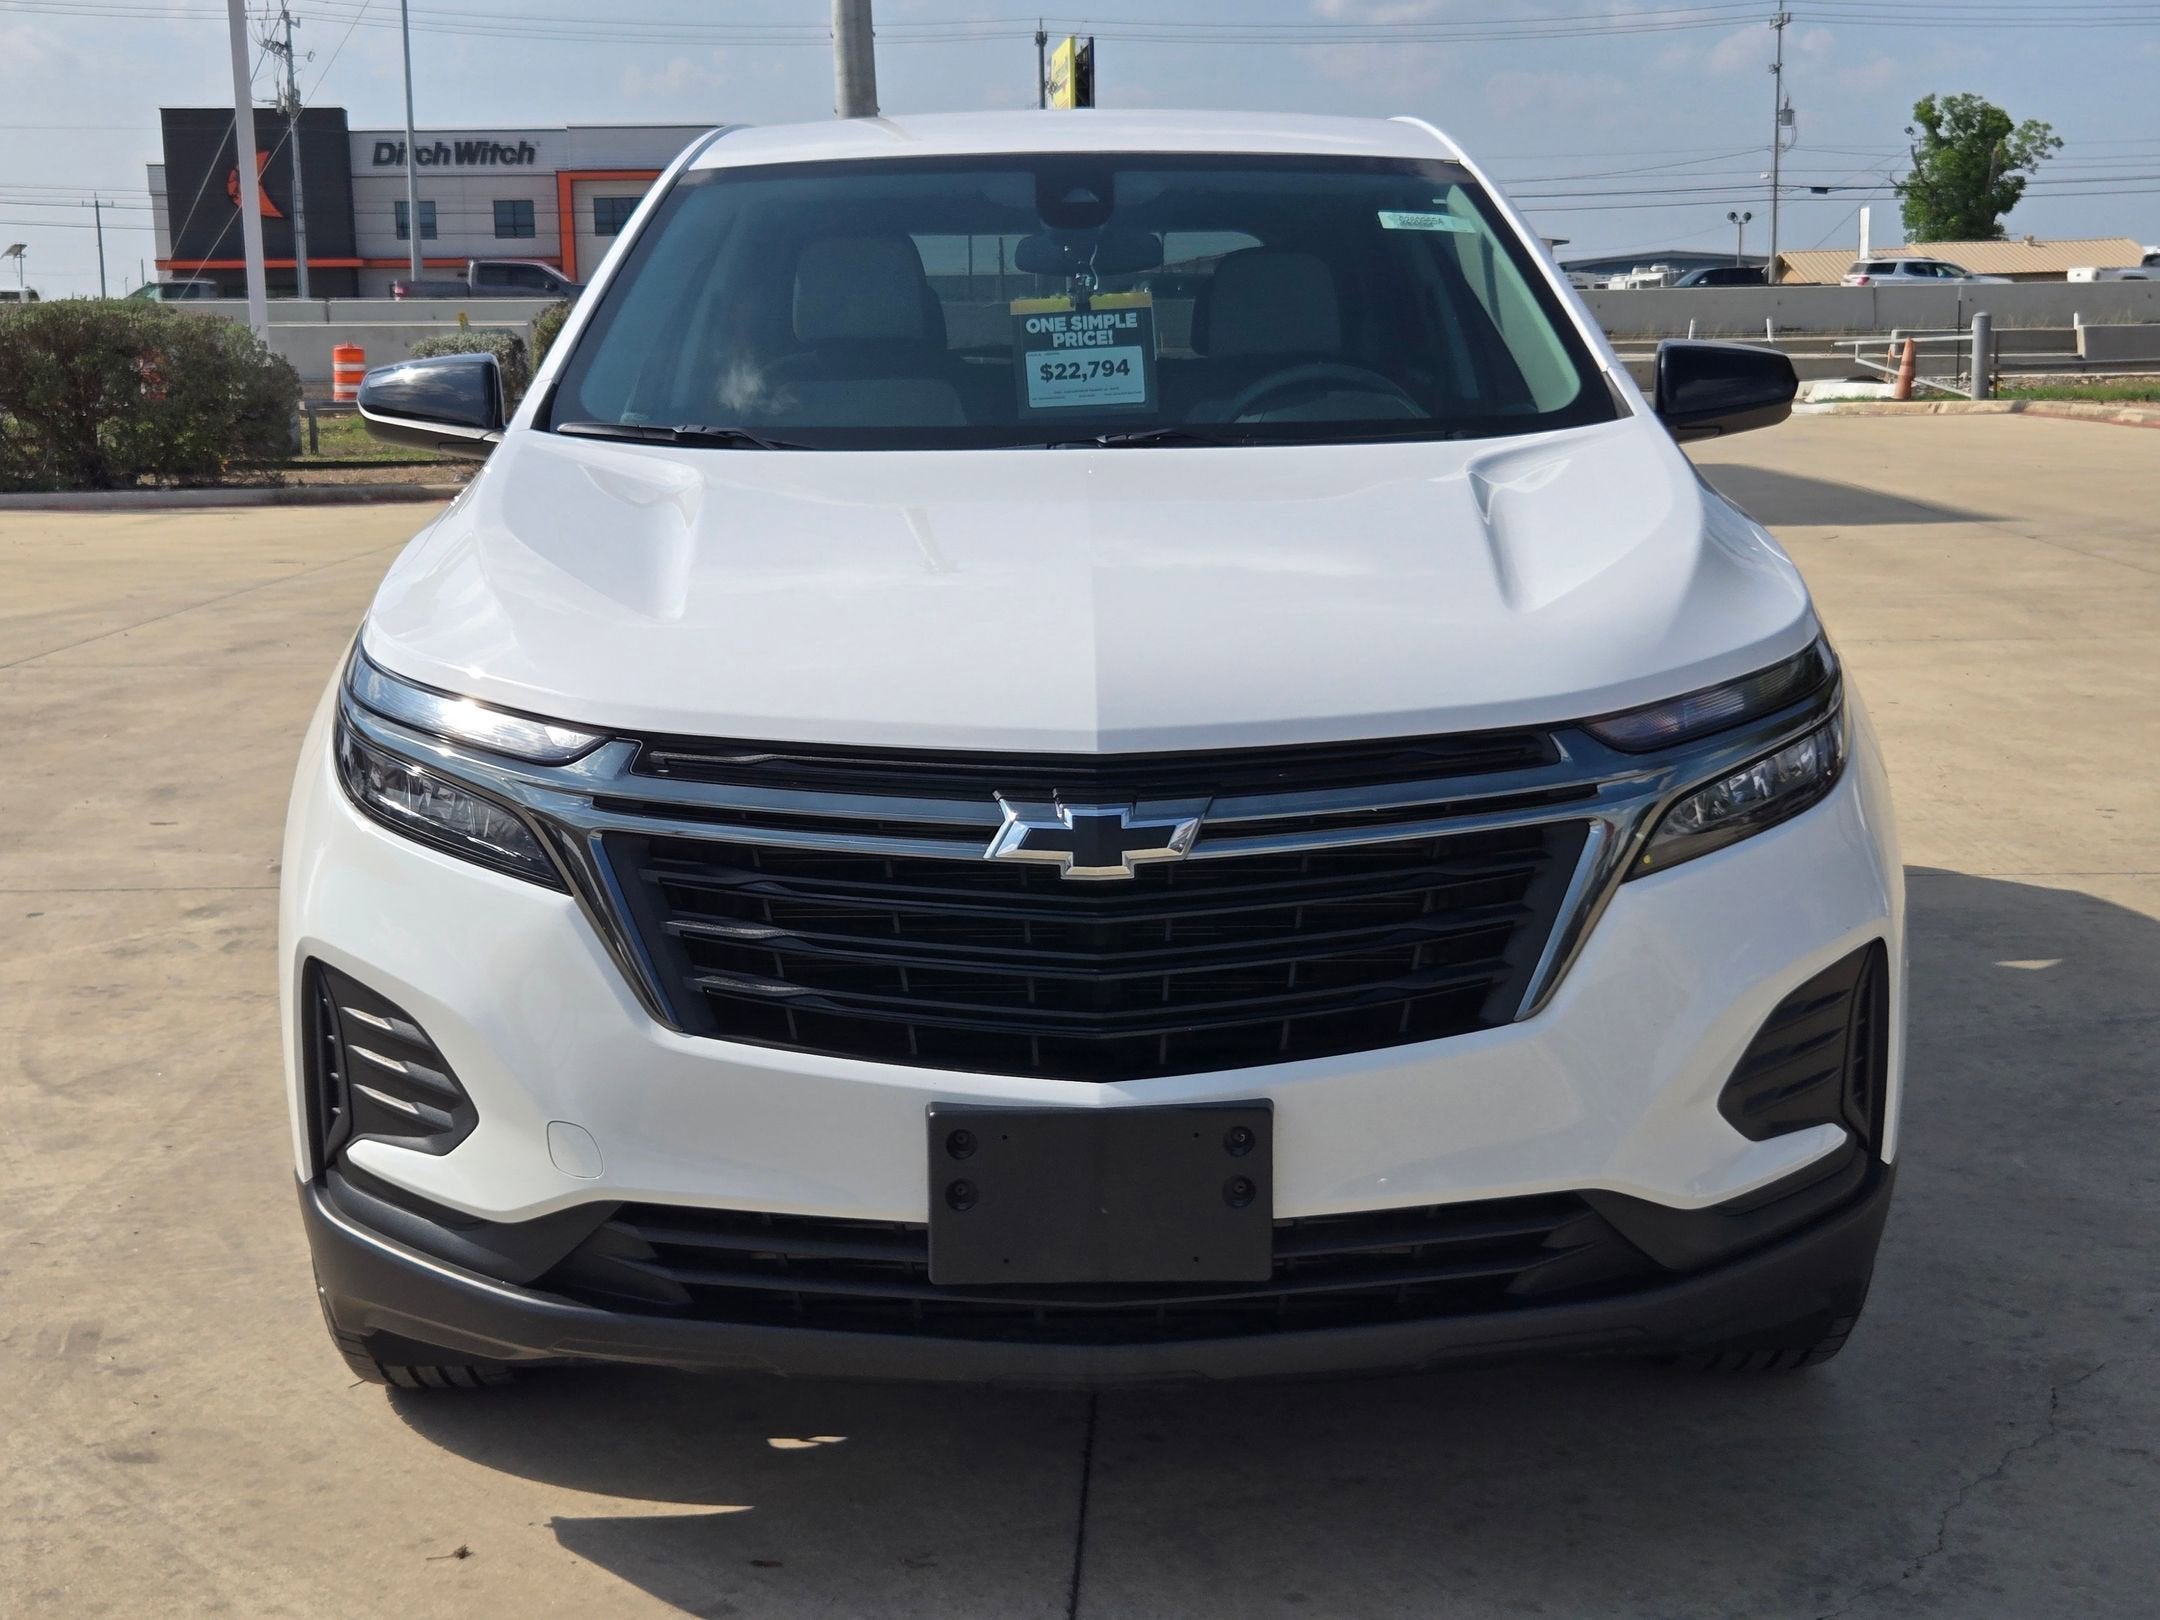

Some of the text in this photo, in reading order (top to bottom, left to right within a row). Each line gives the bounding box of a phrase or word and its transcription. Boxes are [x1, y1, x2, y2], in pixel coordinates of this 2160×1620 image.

[373, 140, 537, 166] Dich Witch
[1025, 312, 1138, 334] ONE SIMPLE
[1052, 329, 1114, 348] PRICE!
[1040, 358, 1130, 383] $22,794
